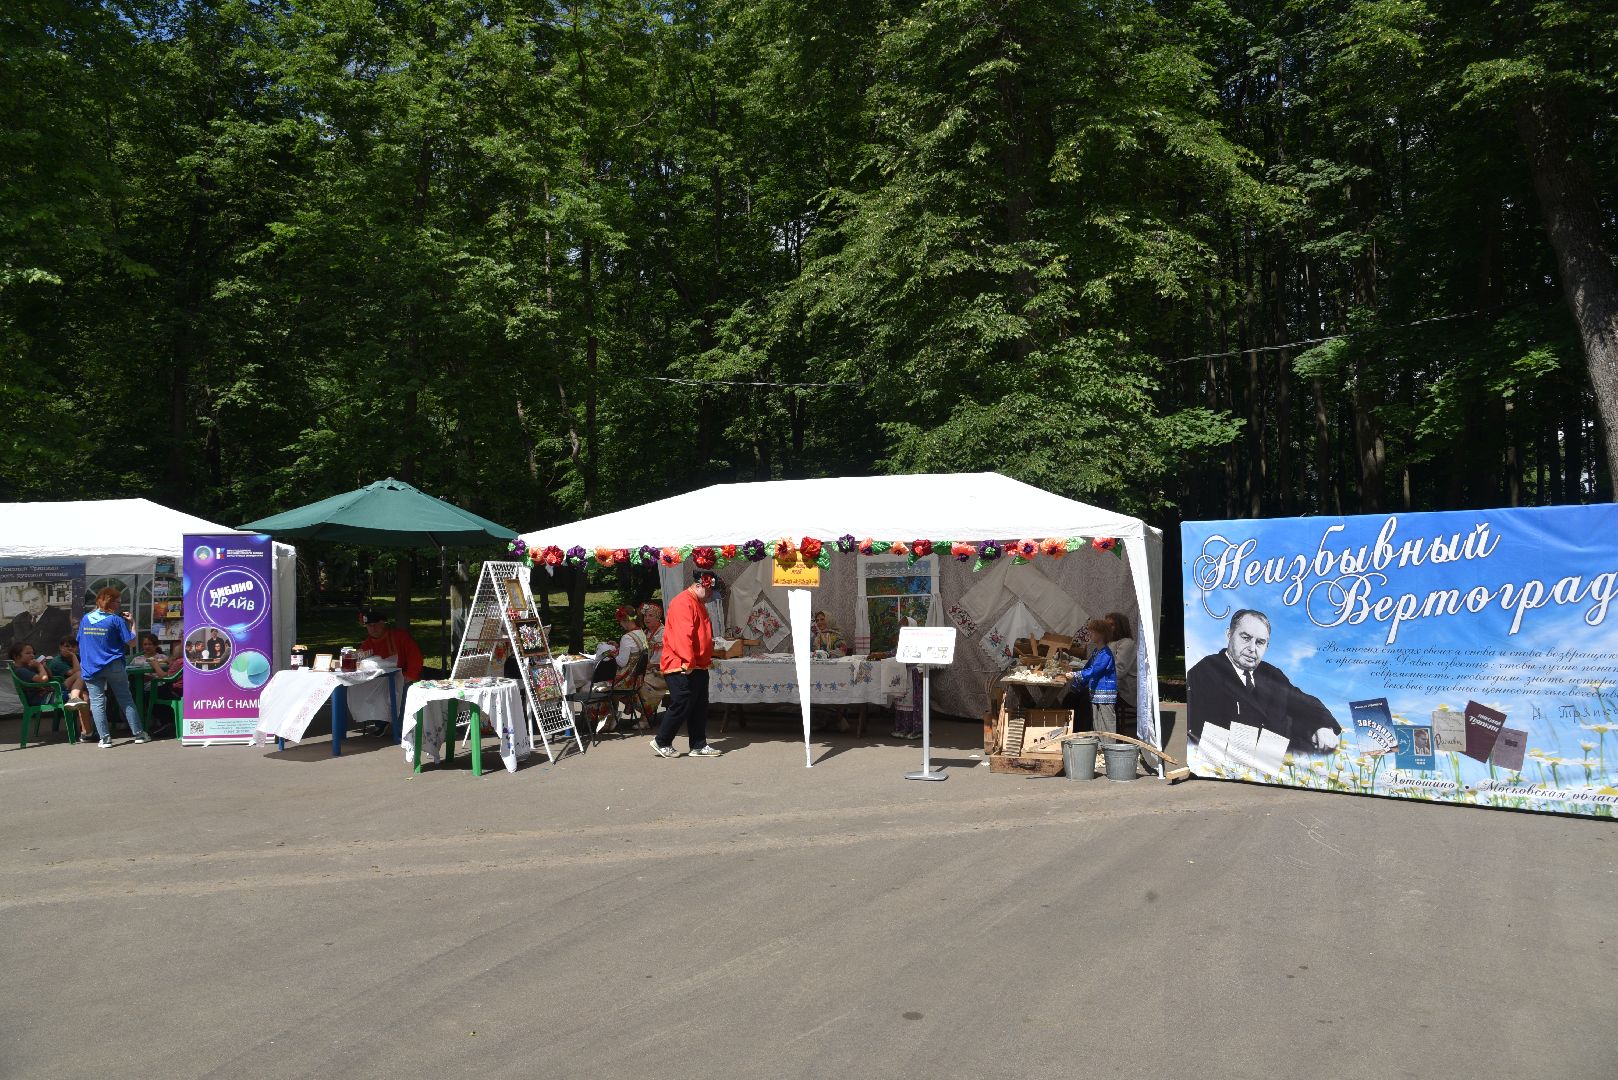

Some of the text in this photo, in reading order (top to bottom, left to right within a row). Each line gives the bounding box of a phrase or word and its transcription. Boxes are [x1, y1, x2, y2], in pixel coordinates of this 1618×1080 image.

[1194, 516, 1500, 619] Неизбывный
[209, 580, 254, 599] БИБЛИО
[209, 596, 255, 611] ДРАЙВ
[1307, 570, 1618, 645] Вертоград
[193, 697, 225, 710] ИГРАЙ
[226, 699, 234, 709] С
[1478, 779, 1567, 799] Московская
